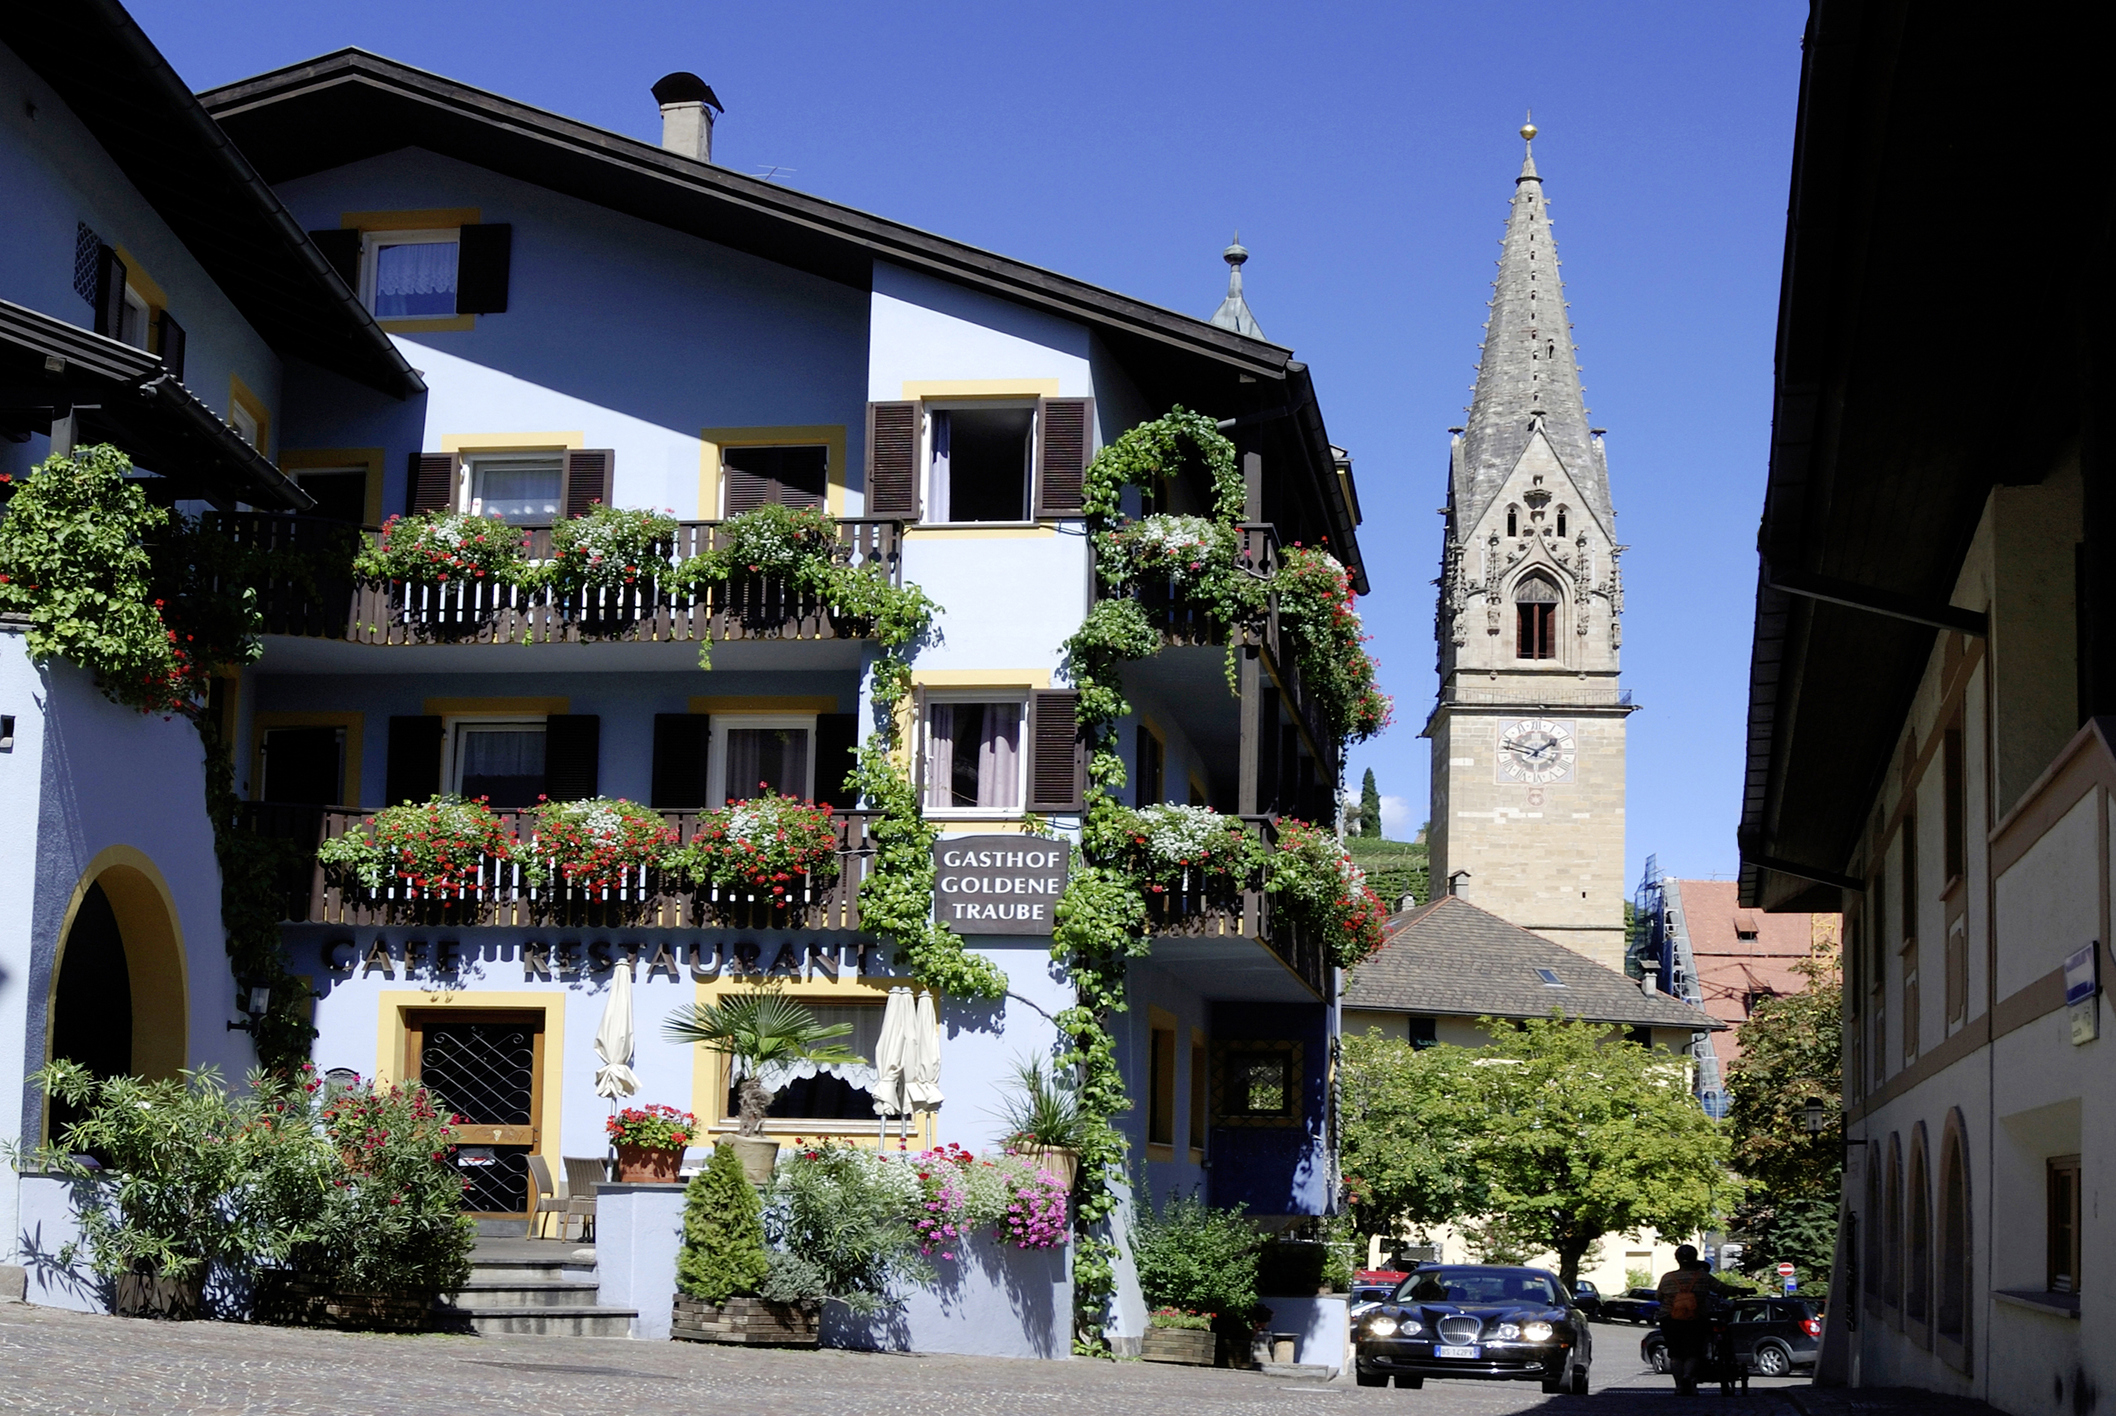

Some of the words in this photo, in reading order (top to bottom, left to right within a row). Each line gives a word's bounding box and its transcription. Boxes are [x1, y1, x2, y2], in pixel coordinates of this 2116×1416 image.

[943, 851, 1060, 868] GASTHOF
[941, 876, 1059, 894] GOLDENE
[952, 903, 1044, 920] TRAUBE
[321, 940, 461, 973] CAFE
[524, 941, 878, 976] RESTAURANT
